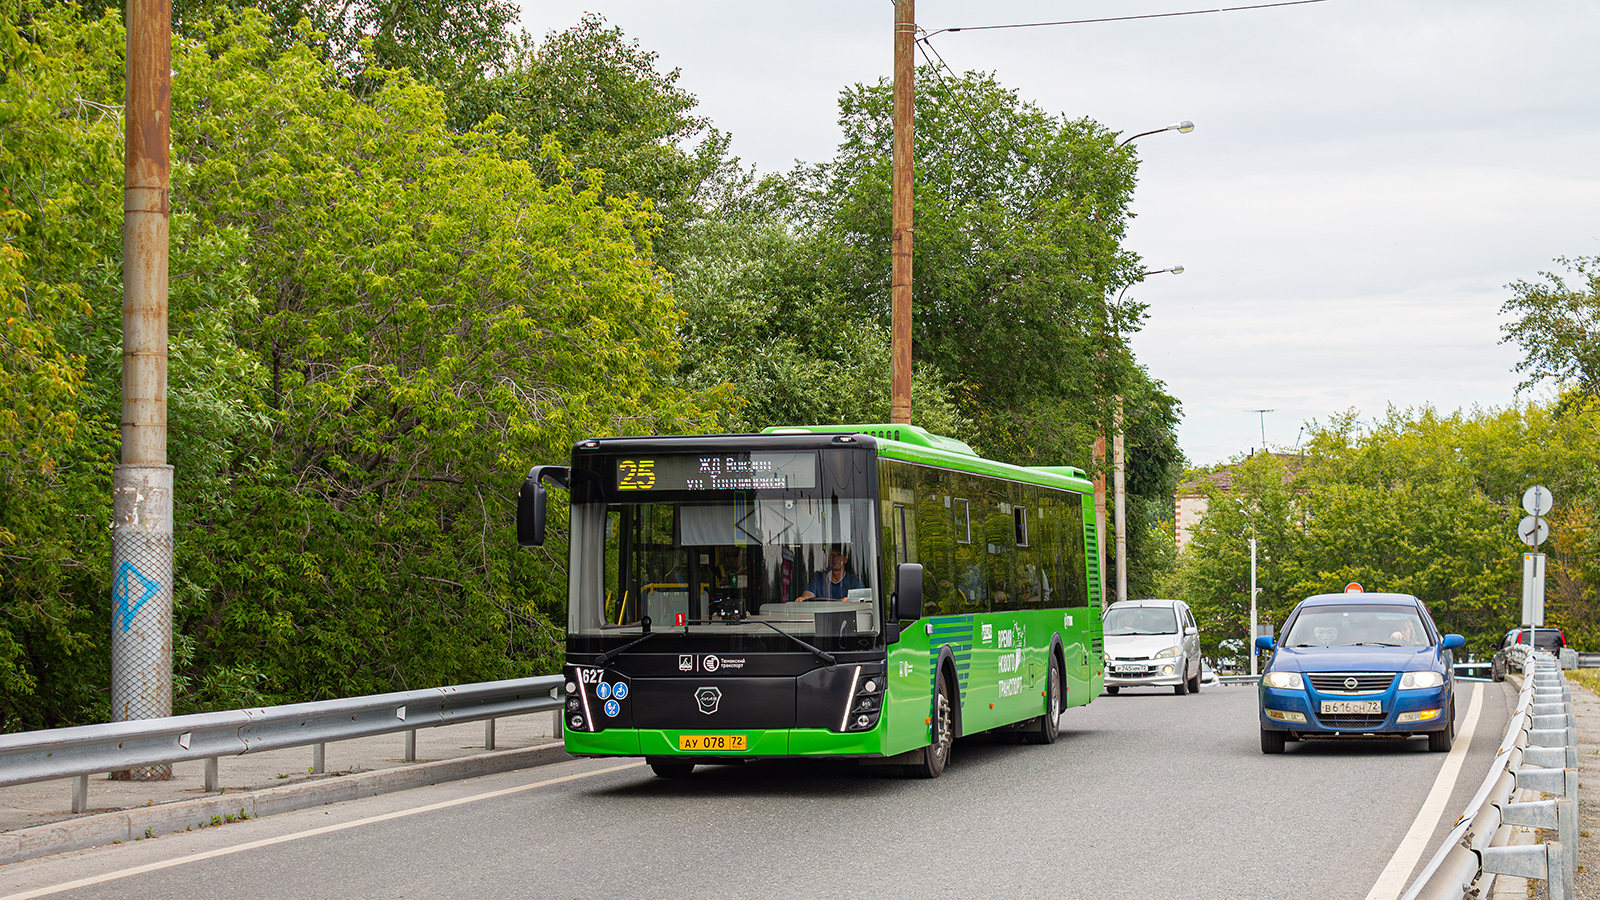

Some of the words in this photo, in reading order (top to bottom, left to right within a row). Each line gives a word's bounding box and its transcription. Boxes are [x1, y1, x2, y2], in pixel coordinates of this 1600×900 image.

[698, 458, 721, 474] ЖД
[617, 459, 656, 490] 25
[583, 668, 604, 684] 627
[685, 739, 698, 748] АУ
[703, 737, 725, 748] 078
[731, 736, 743, 745] 72
